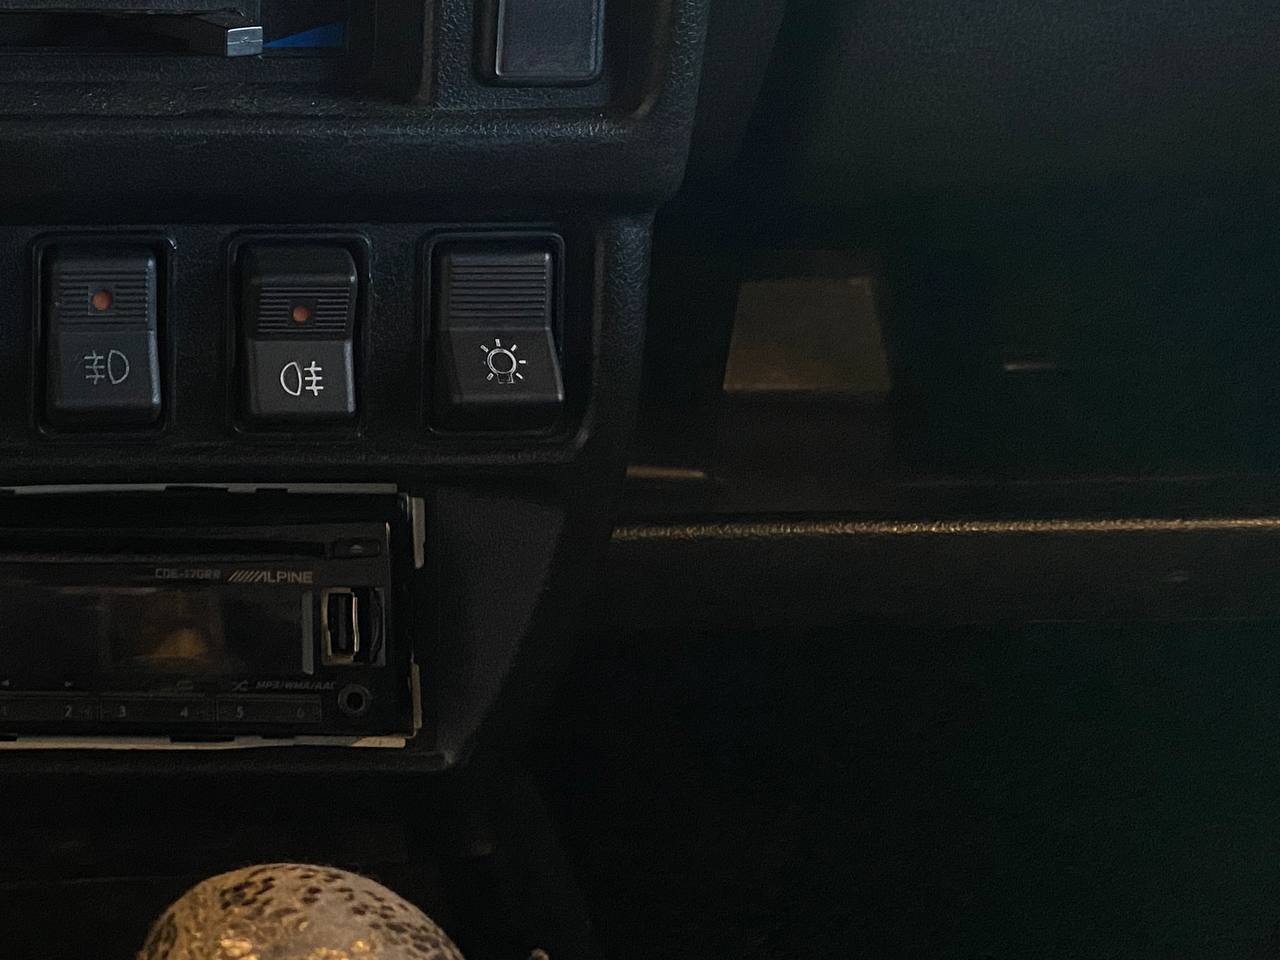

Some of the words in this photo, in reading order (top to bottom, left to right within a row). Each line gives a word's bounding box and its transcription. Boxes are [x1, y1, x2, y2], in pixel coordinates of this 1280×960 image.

[252, 569, 315, 584] ALPINE
[118, 705, 127, 718] 3
[179, 705, 189, 718] 4
[236, 705, 245, 718] 5
